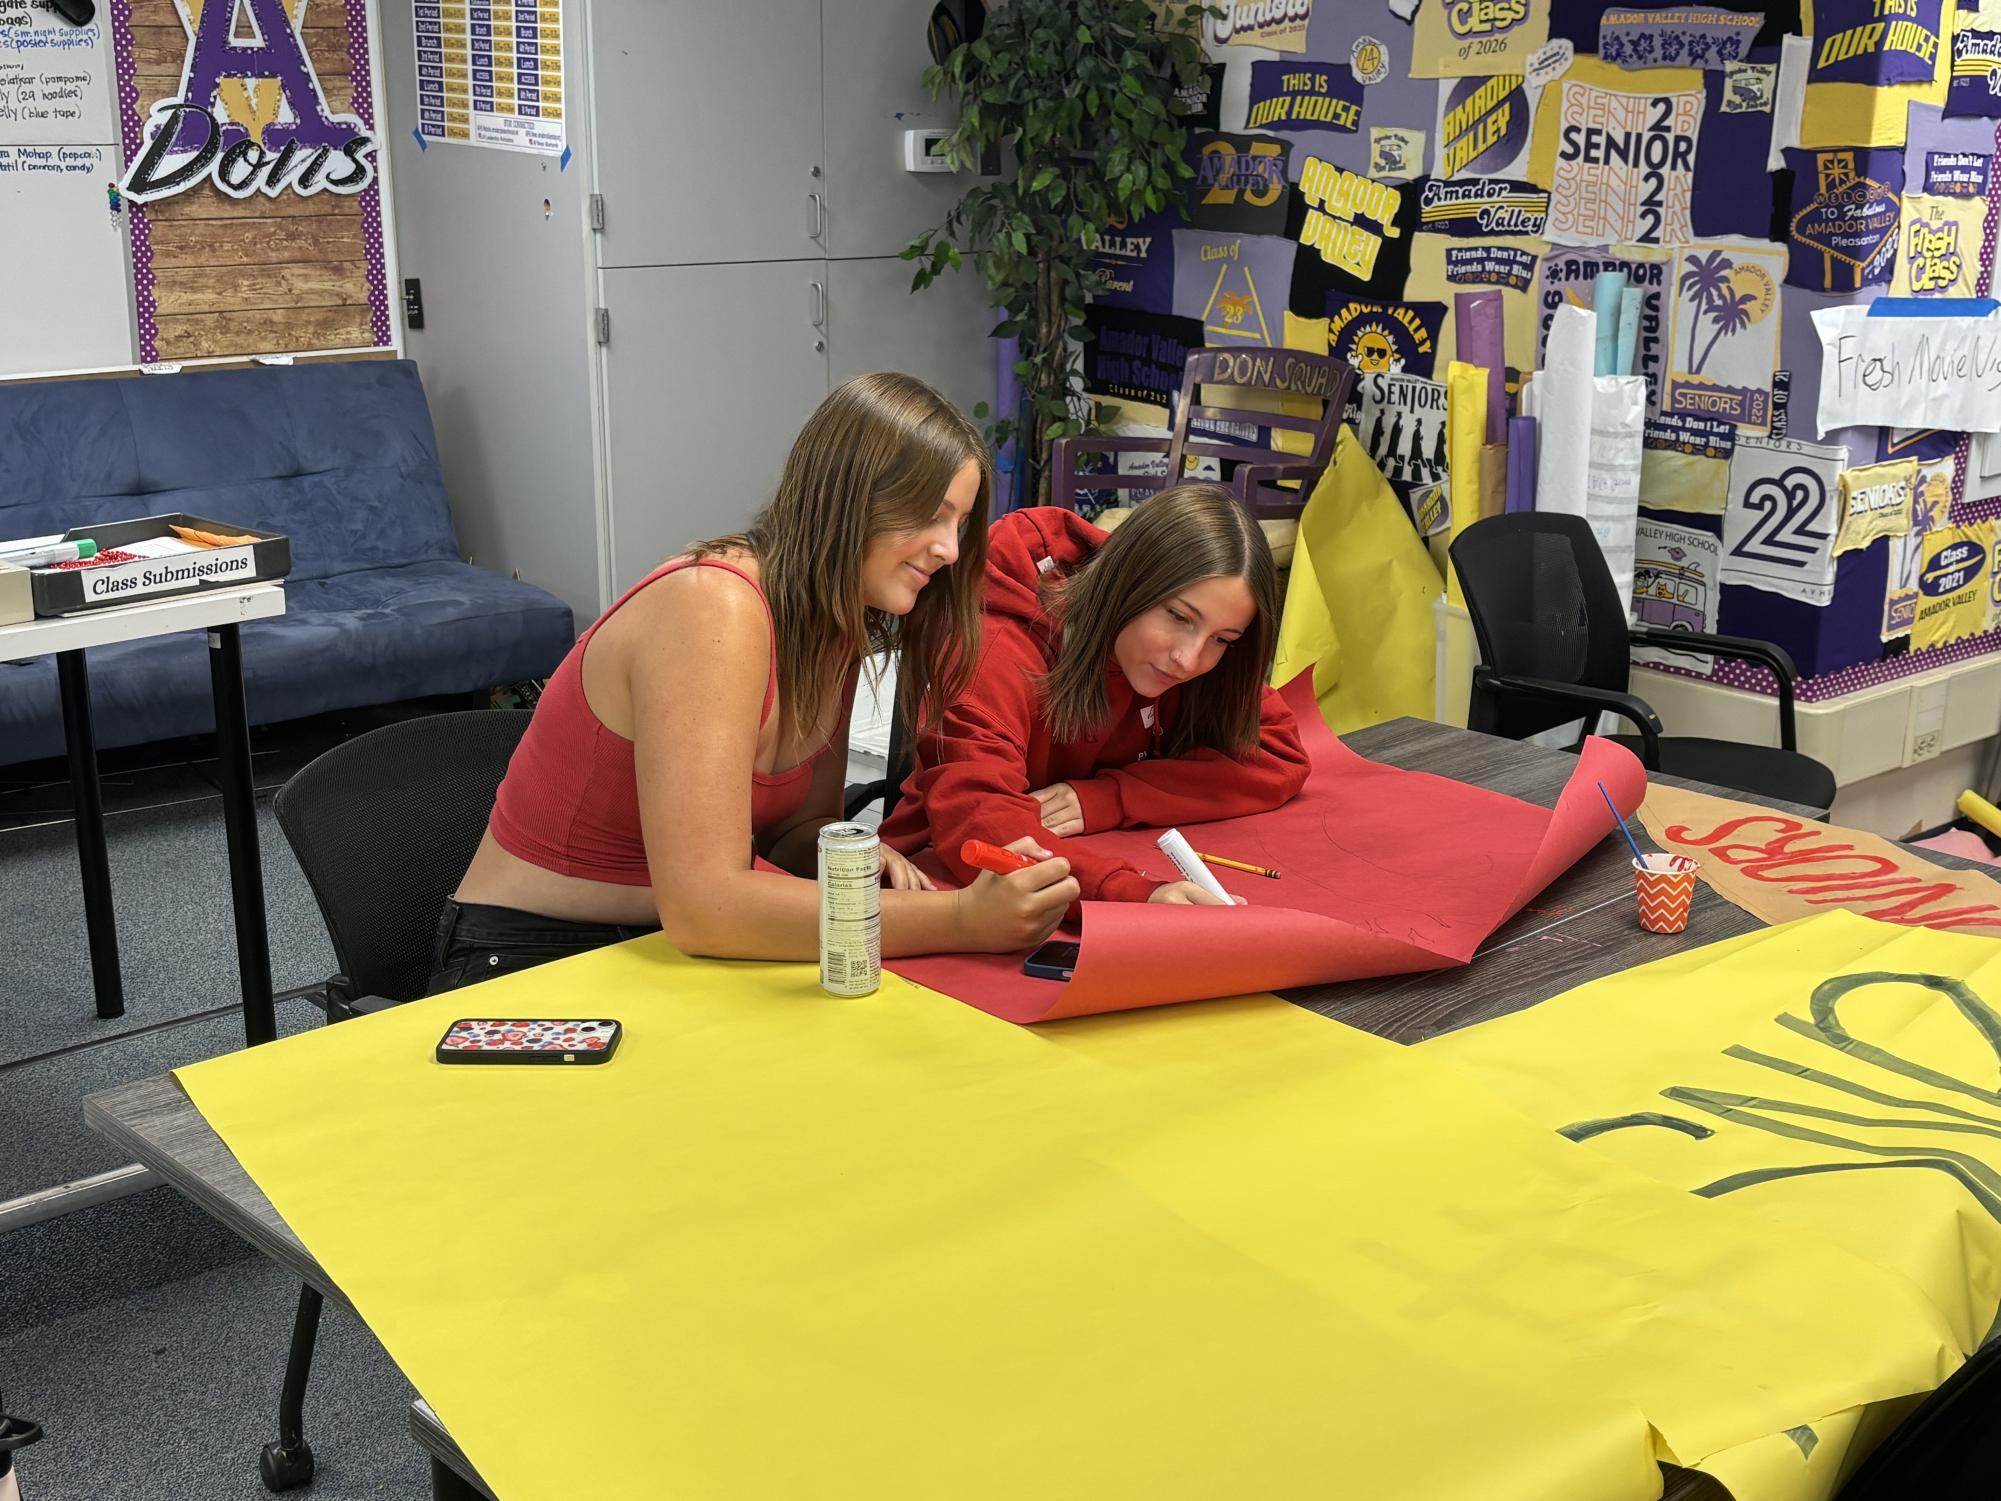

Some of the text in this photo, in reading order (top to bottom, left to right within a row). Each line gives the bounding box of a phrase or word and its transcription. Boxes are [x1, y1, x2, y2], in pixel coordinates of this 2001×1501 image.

[1600, 13, 1762, 28] AMADOR VALLEY HIGH SCHOOL
[421, 36, 438, 47] Brunch
[1458, 38, 1508, 60] of 2026
[1817, 20, 1940, 70] OUR HOUSE
[476, 56, 489, 65] Lunch
[521, 59, 534, 69] Lunch
[424, 81, 439, 91] Lunch
[1281, 74, 1329, 93] THIS IS
[1249, 95, 1361, 131] OUR HOUSE
[126, 103, 375, 195] Dons
[1443, 101, 1512, 180] VALLEY
[1196, 154, 1288, 188] AMADOR
[1298, 155, 1402, 238] AMADOR
[1420, 179, 1511, 209] Amador
[1813, 181, 1892, 206] WELCOME
[1476, 204, 1546, 236] Valley
[1820, 202, 1886, 221] TO Fabulous
[1929, 206, 1945, 221] The
[1805, 211, 1895, 236] AMADOR VALLEY
[1201, 240, 1241, 261] Class of
[1831, 234, 1880, 248] Pleasanton
[1451, 247, 1532, 264] Friends Don't Let
[1096, 268, 1134, 293] Parent
[1447, 261, 1532, 280] Friends Wear Blue
[1734, 264, 1767, 281] AMADOR
[1222, 304, 1245, 325] 23
[1213, 352, 1341, 398] DON SQUAD
[1838, 333, 1967, 399] Fresh Movie
[1675, 388, 1765, 424] SENIORS 2022
[1772, 387, 1789, 403] OF
[1712, 421, 1731, 434] Let
[1771, 409, 1788, 440] CLASS
[1645, 429, 1732, 449] riends Wear Blue
[1849, 480, 1908, 516] SENIORS
[1729, 465, 1832, 568] 22
[1664, 533, 1688, 546] HIGH
[1686, 537, 1720, 557] SCHOOL
[1940, 546, 1969, 567] Class
[92, 555, 249, 596] Class Submissions
[1937, 571, 1965, 593] 2021
[1890, 602, 1916, 625] SENIO
[1918, 589, 1978, 622] AMADOR VALLEY
